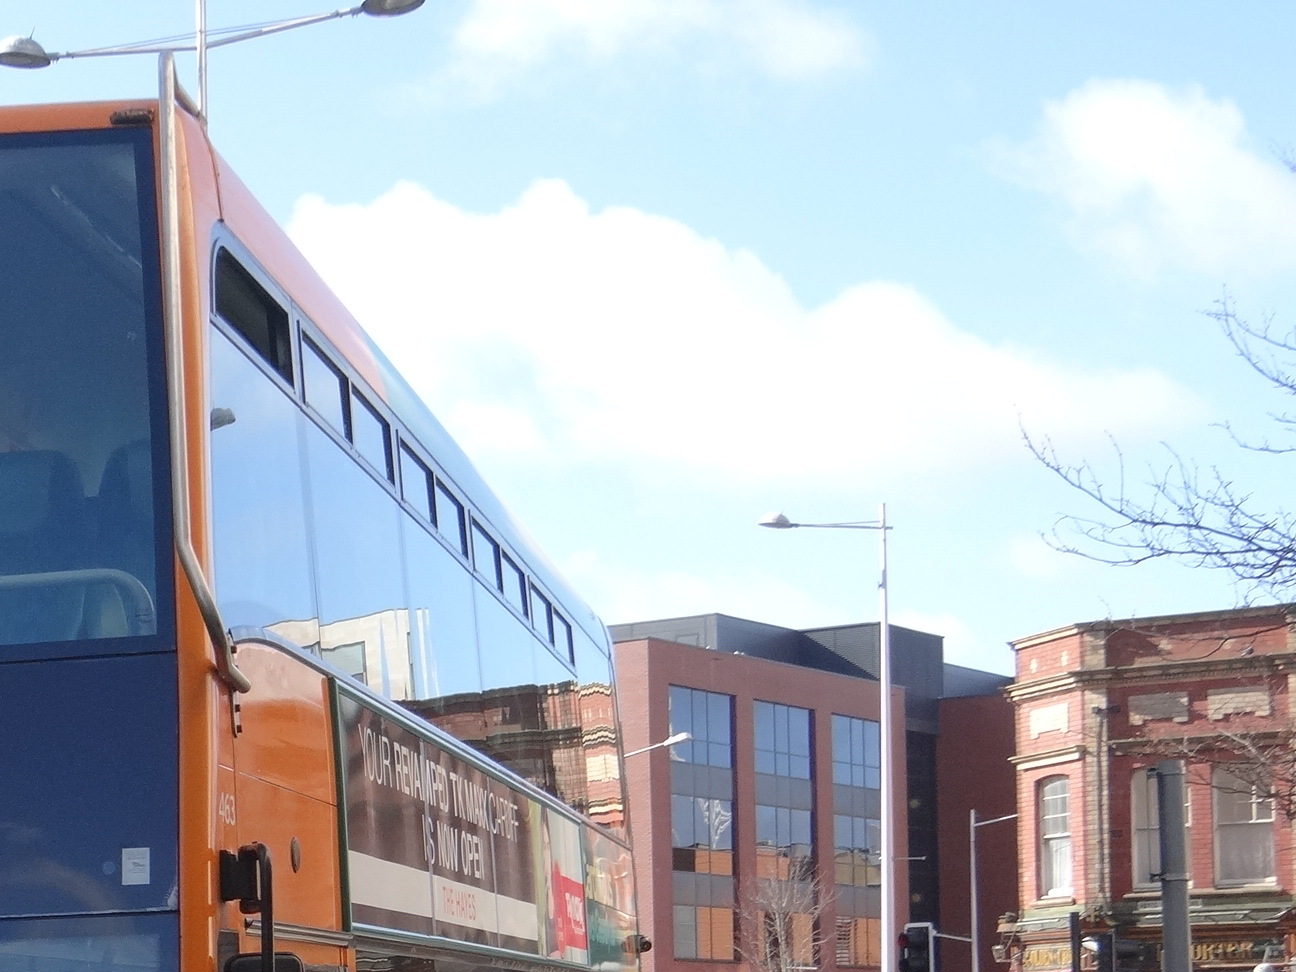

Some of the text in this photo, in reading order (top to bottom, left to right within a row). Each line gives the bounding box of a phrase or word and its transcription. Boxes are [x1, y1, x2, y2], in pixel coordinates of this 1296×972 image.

[358, 724, 393, 788] YOUR
[394, 742, 449, 813] REVAMPED
[219, 792, 235, 825] 463
[422, 814, 484, 880] IS NOW OPEN
